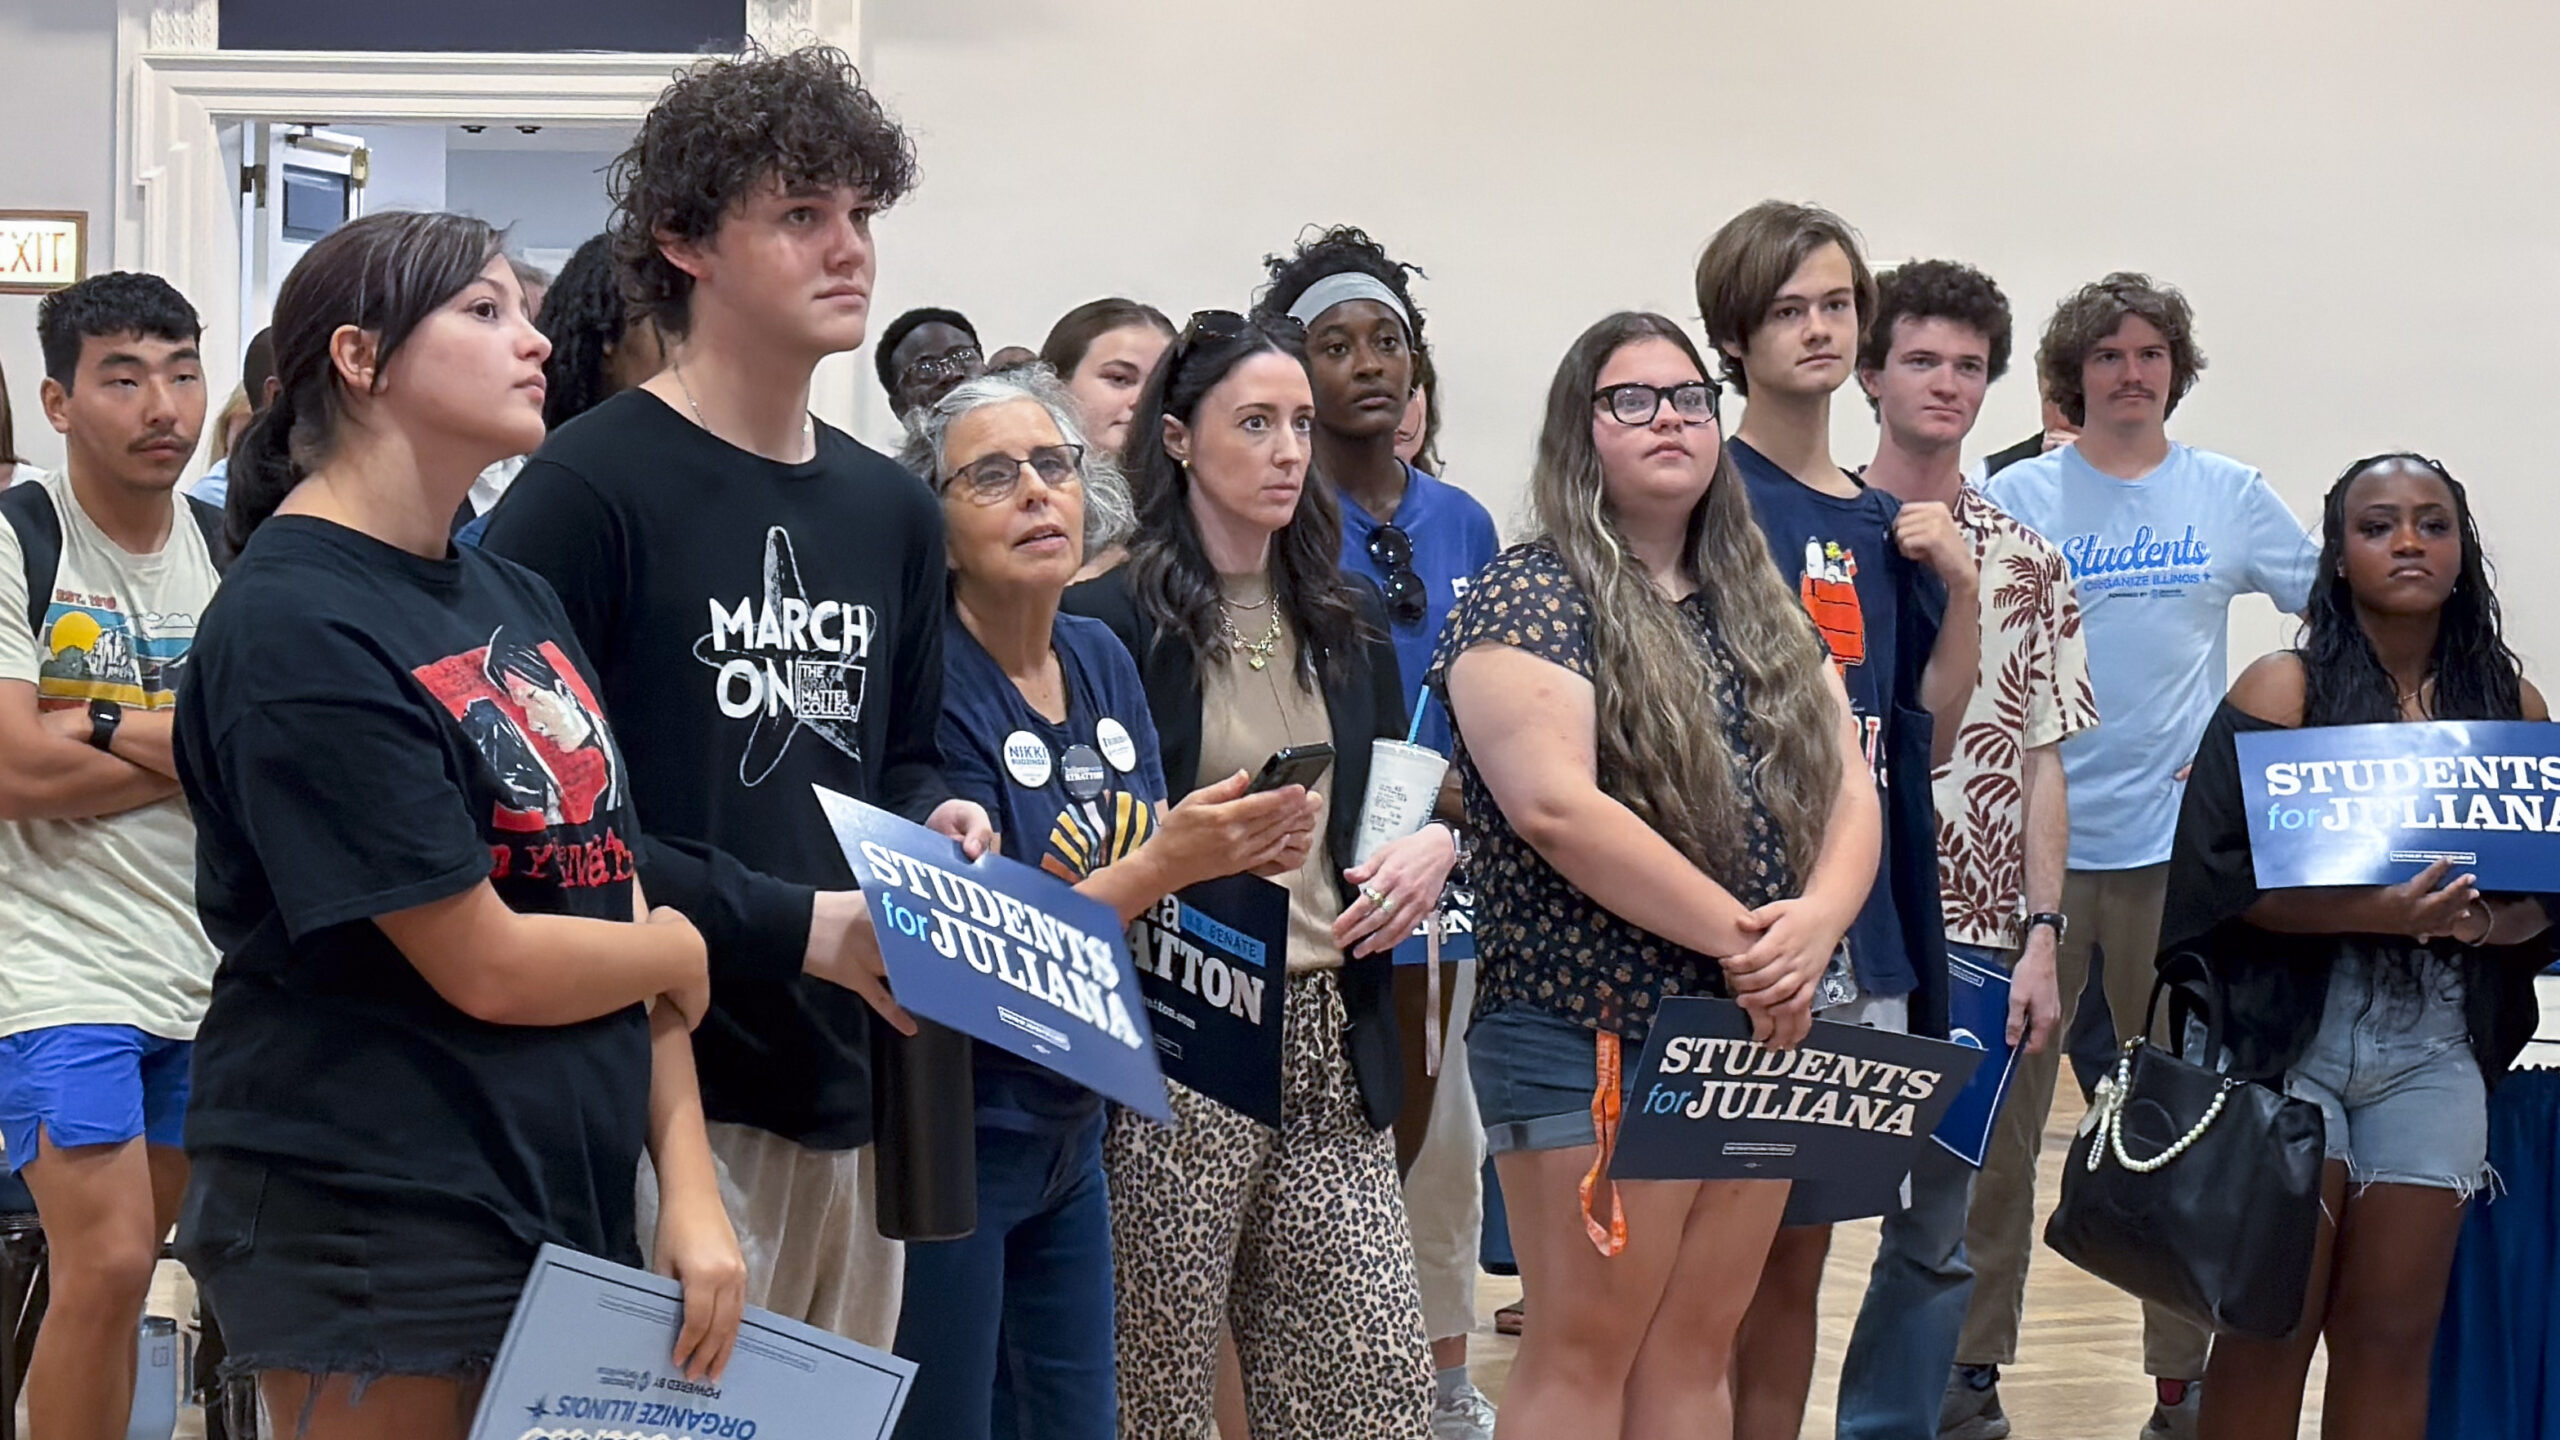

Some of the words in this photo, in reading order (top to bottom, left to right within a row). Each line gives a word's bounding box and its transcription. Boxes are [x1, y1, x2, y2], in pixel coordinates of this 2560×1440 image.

[2062, 524, 2211, 579] Students
[2084, 576, 2149, 591] ORGANIZE
[2153, 573, 2200, 587] ILLINOIS
[709, 596, 868, 658] MARCH
[716, 658, 795, 719] ON
[801, 665, 826, 678] THE
[801, 689, 849, 704] MATTER
[1009, 745, 1048, 759] NIKKI
[2265, 755, 2560, 797] STUDENTS
[2267, 802, 2319, 832] for
[2321, 794, 2560, 833] JULIAN
[859, 840, 1122, 990] STUDENTS
[1208, 923, 1258, 958] SENATE
[882, 891, 929, 942] for
[929, 907, 1144, 1050] JULIANA
[1128, 918, 1265, 1026] ATTON
[1658, 1036, 1943, 1100] STUDENTS
[1641, 1083, 1693, 1116] for
[1684, 1080, 1917, 1137] JULIANA
[556, 1395, 638, 1419] ILLINOIS
[636, 1402, 757, 1440] ORGANIZE
